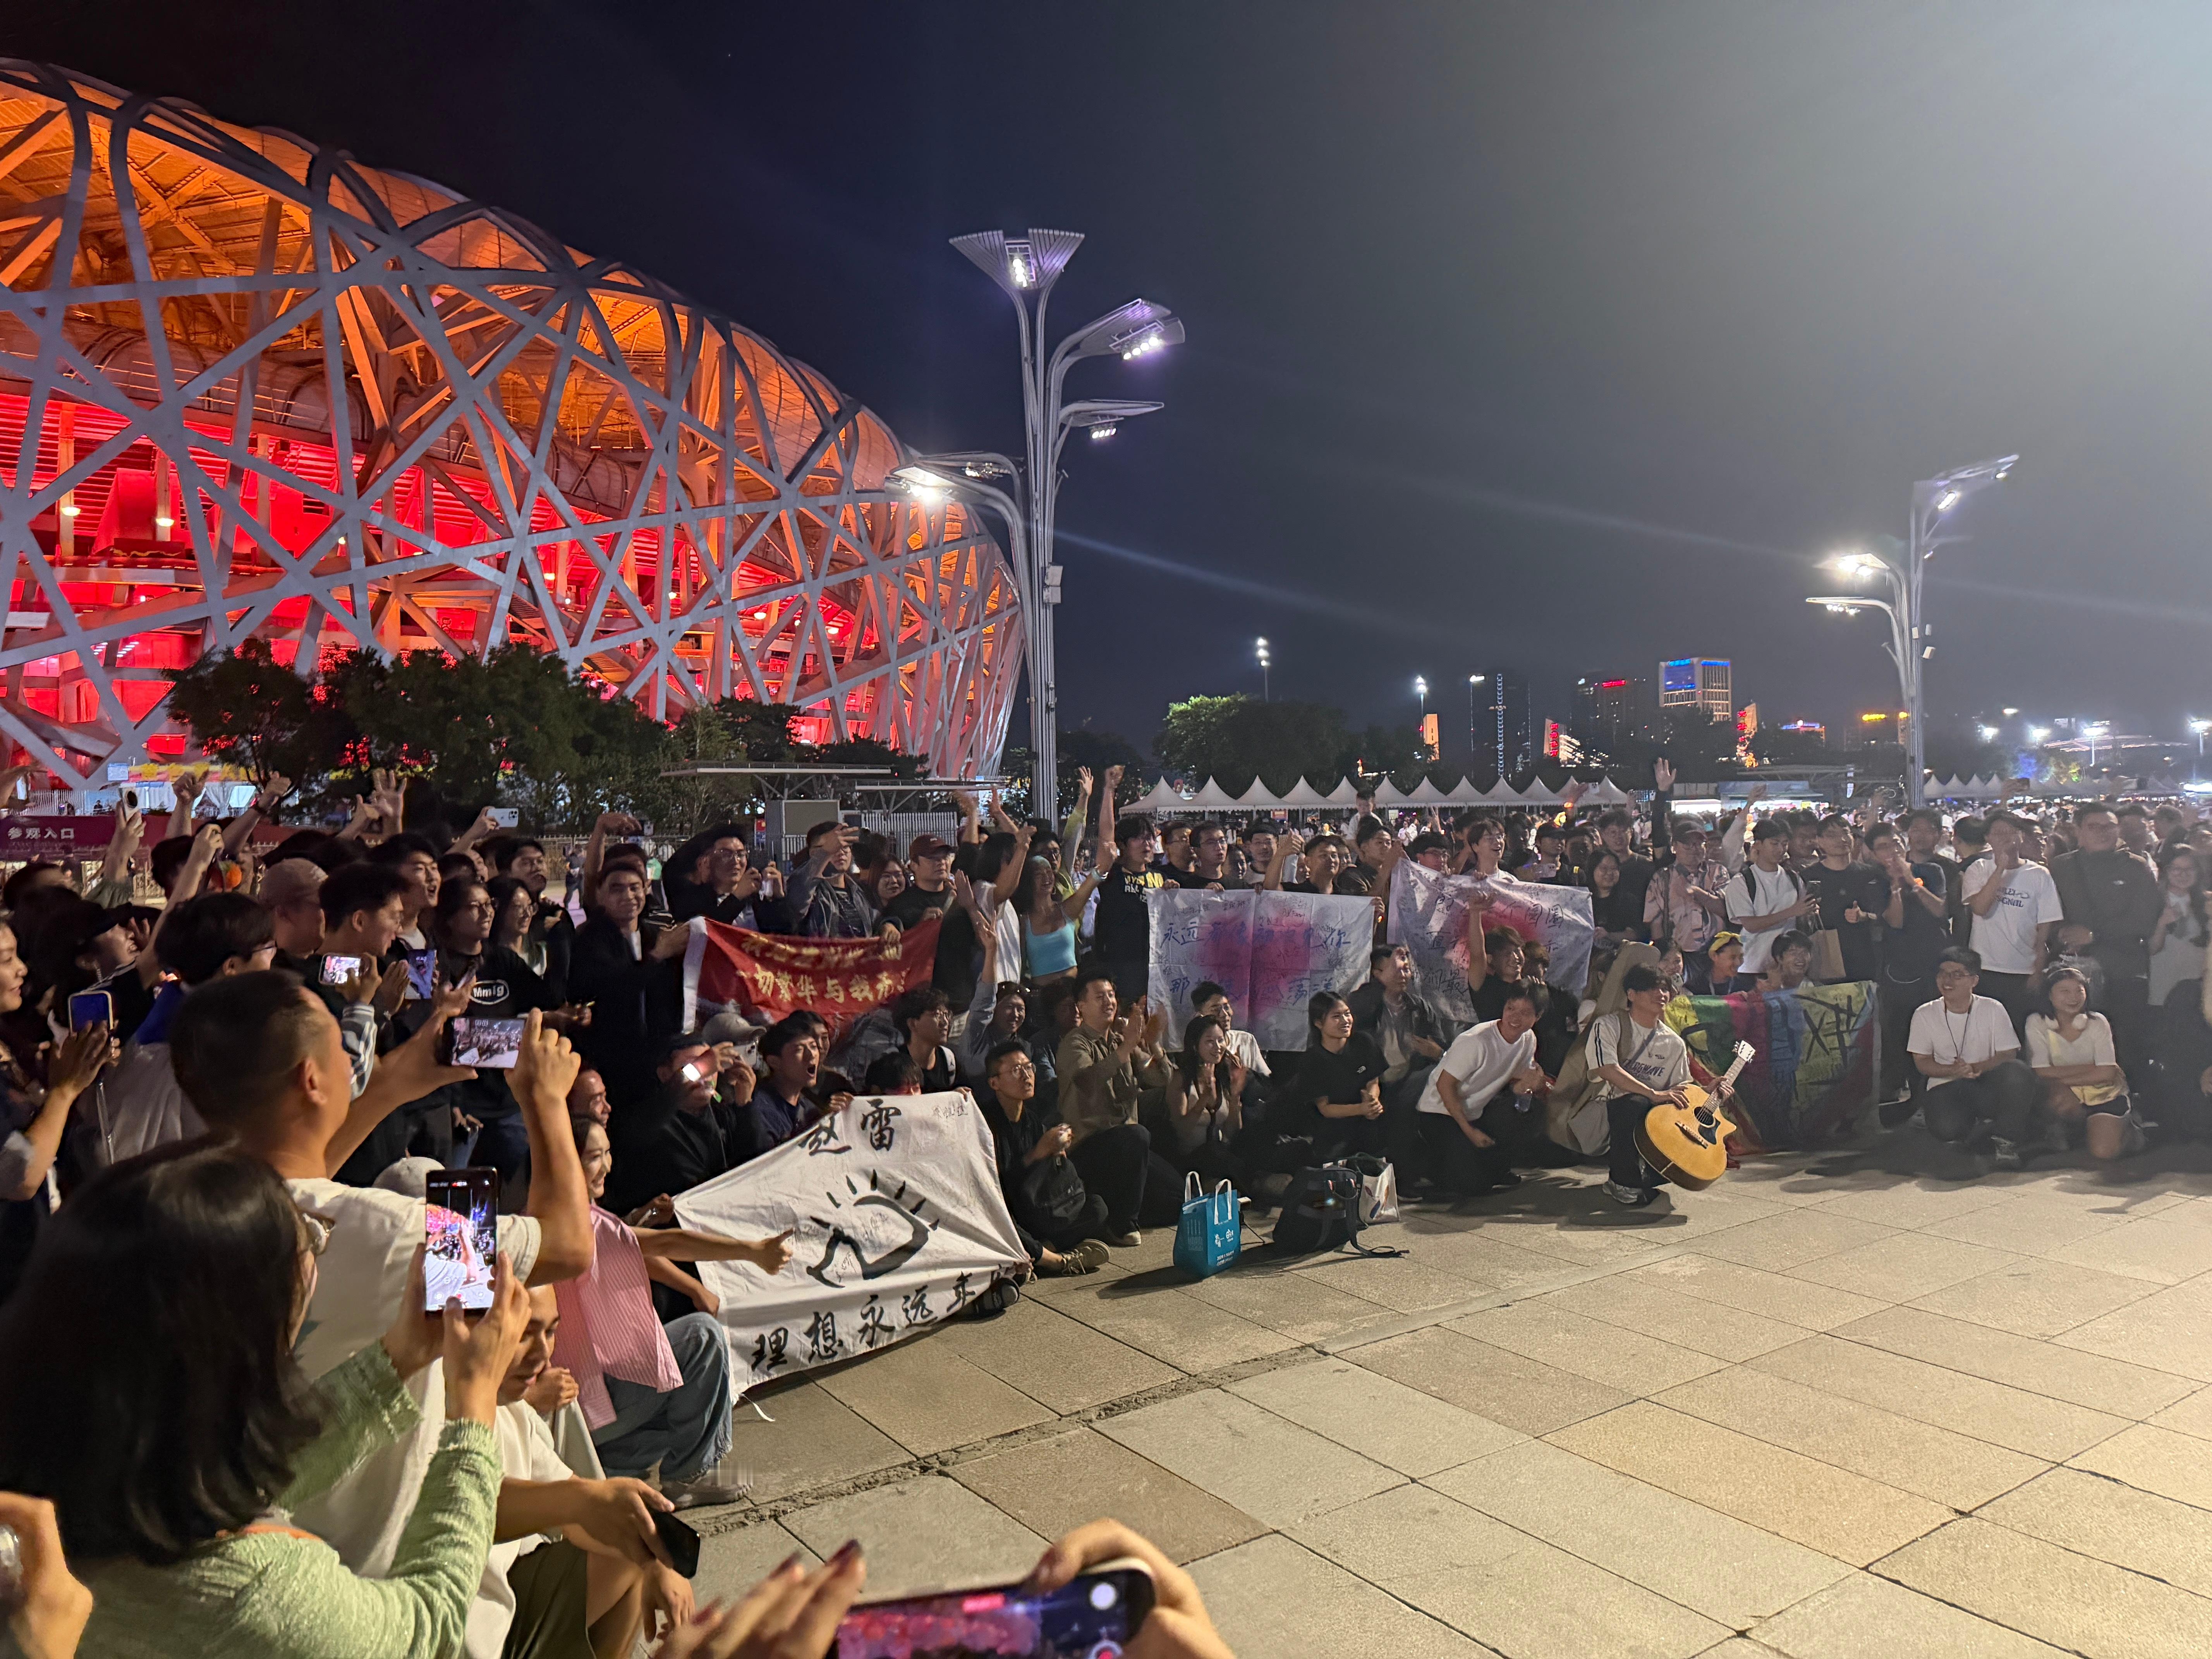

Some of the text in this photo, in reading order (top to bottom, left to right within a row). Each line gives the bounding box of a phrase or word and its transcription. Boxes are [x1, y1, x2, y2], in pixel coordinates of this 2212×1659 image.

[8, 827, 74, 840] 参观入口
[798, 1098, 902, 1156] 赵雷
